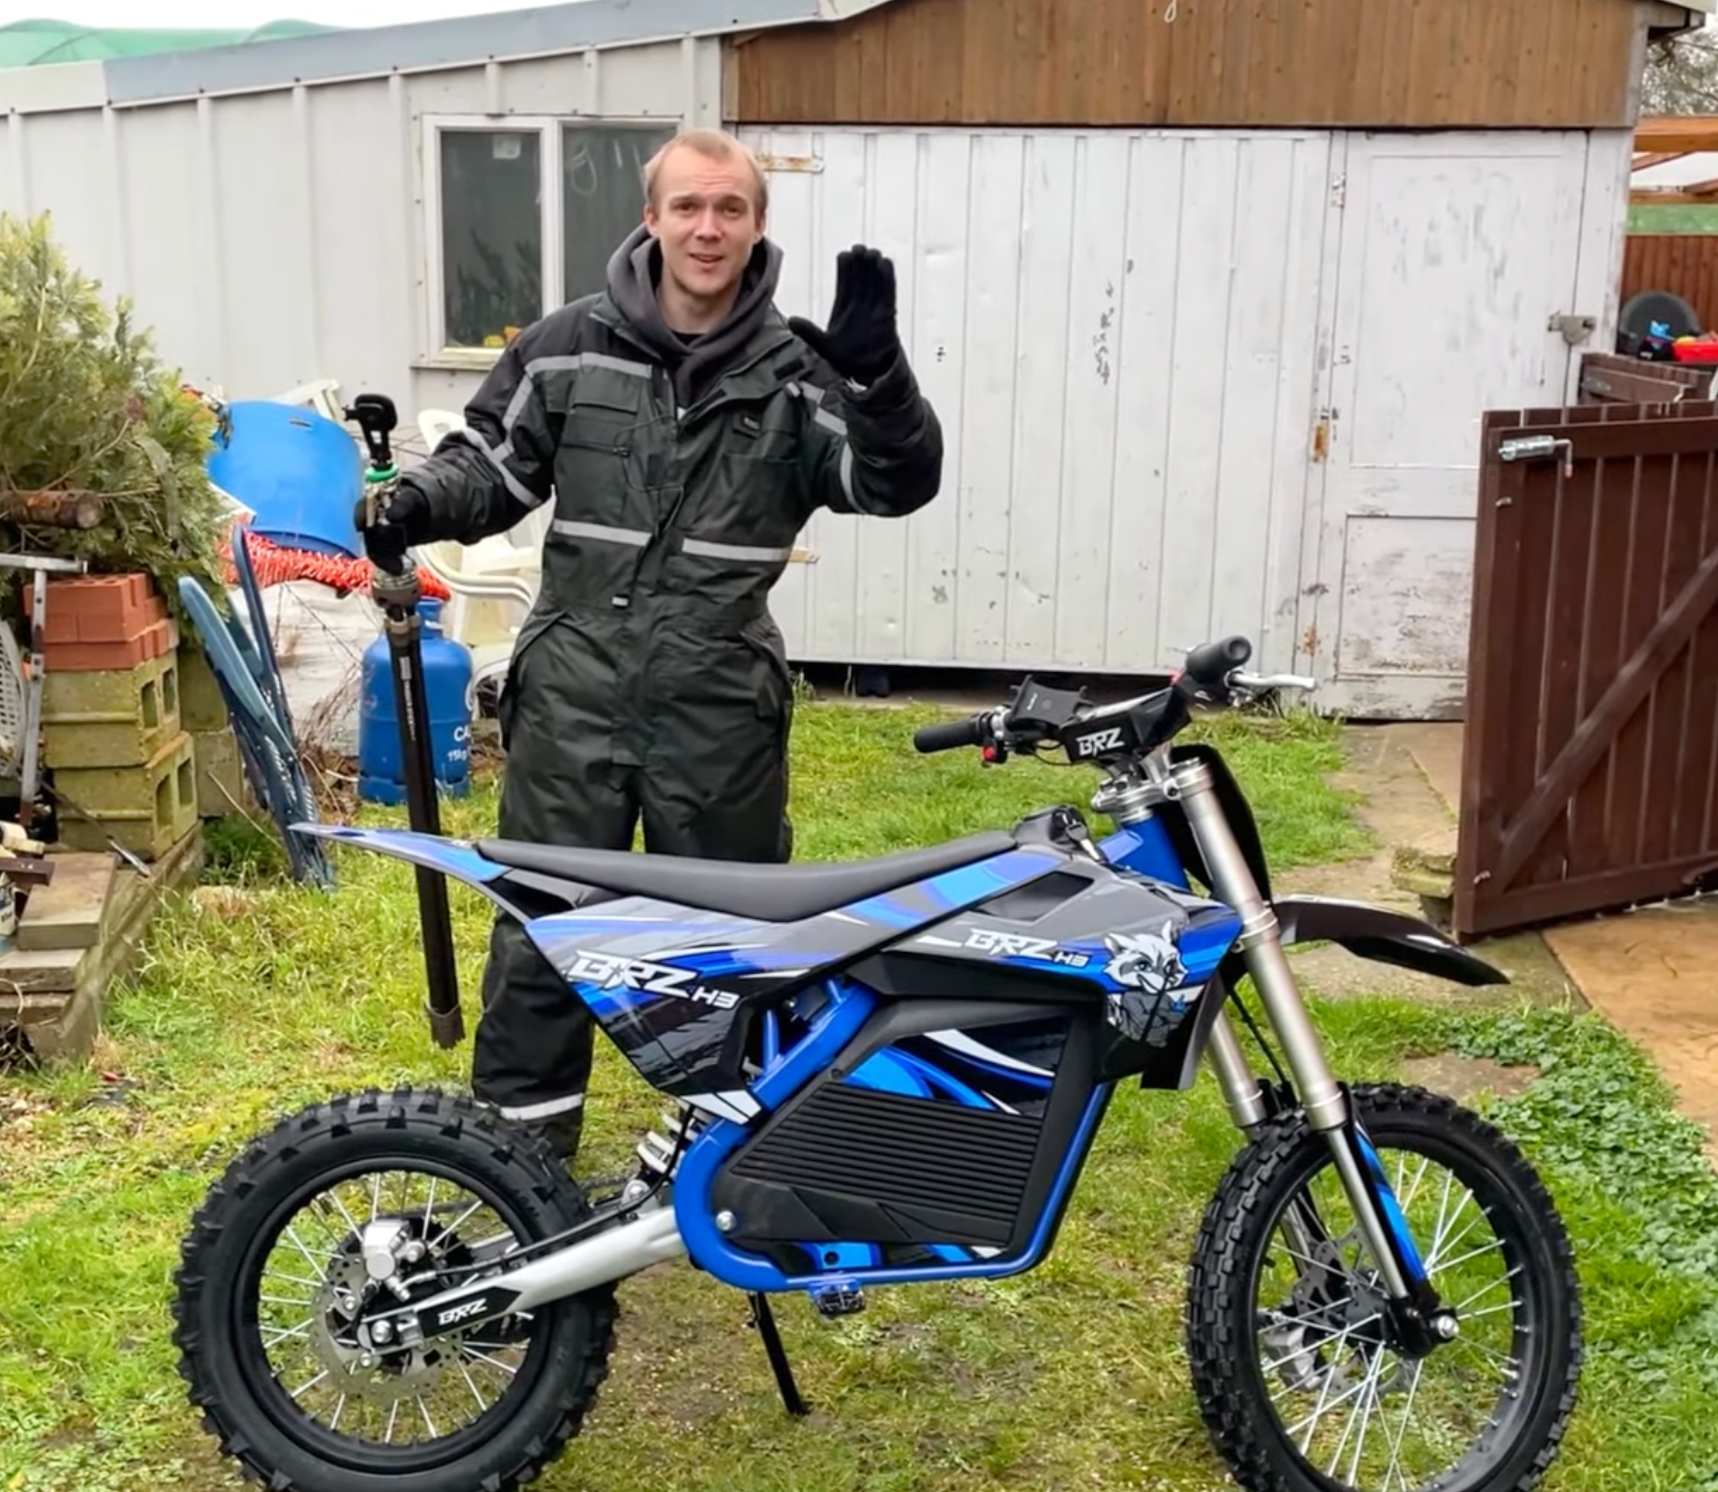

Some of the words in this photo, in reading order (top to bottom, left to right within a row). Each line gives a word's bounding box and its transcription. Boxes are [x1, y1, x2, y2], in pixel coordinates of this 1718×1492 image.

[1075, 727, 1125, 758] BRZ
[964, 928, 1058, 959] BRZ
[1054, 953, 1089, 968] H3
[567, 950, 697, 998] BRZ
[691, 986, 739, 1009] H3
[437, 1298, 487, 1325] BRZ
